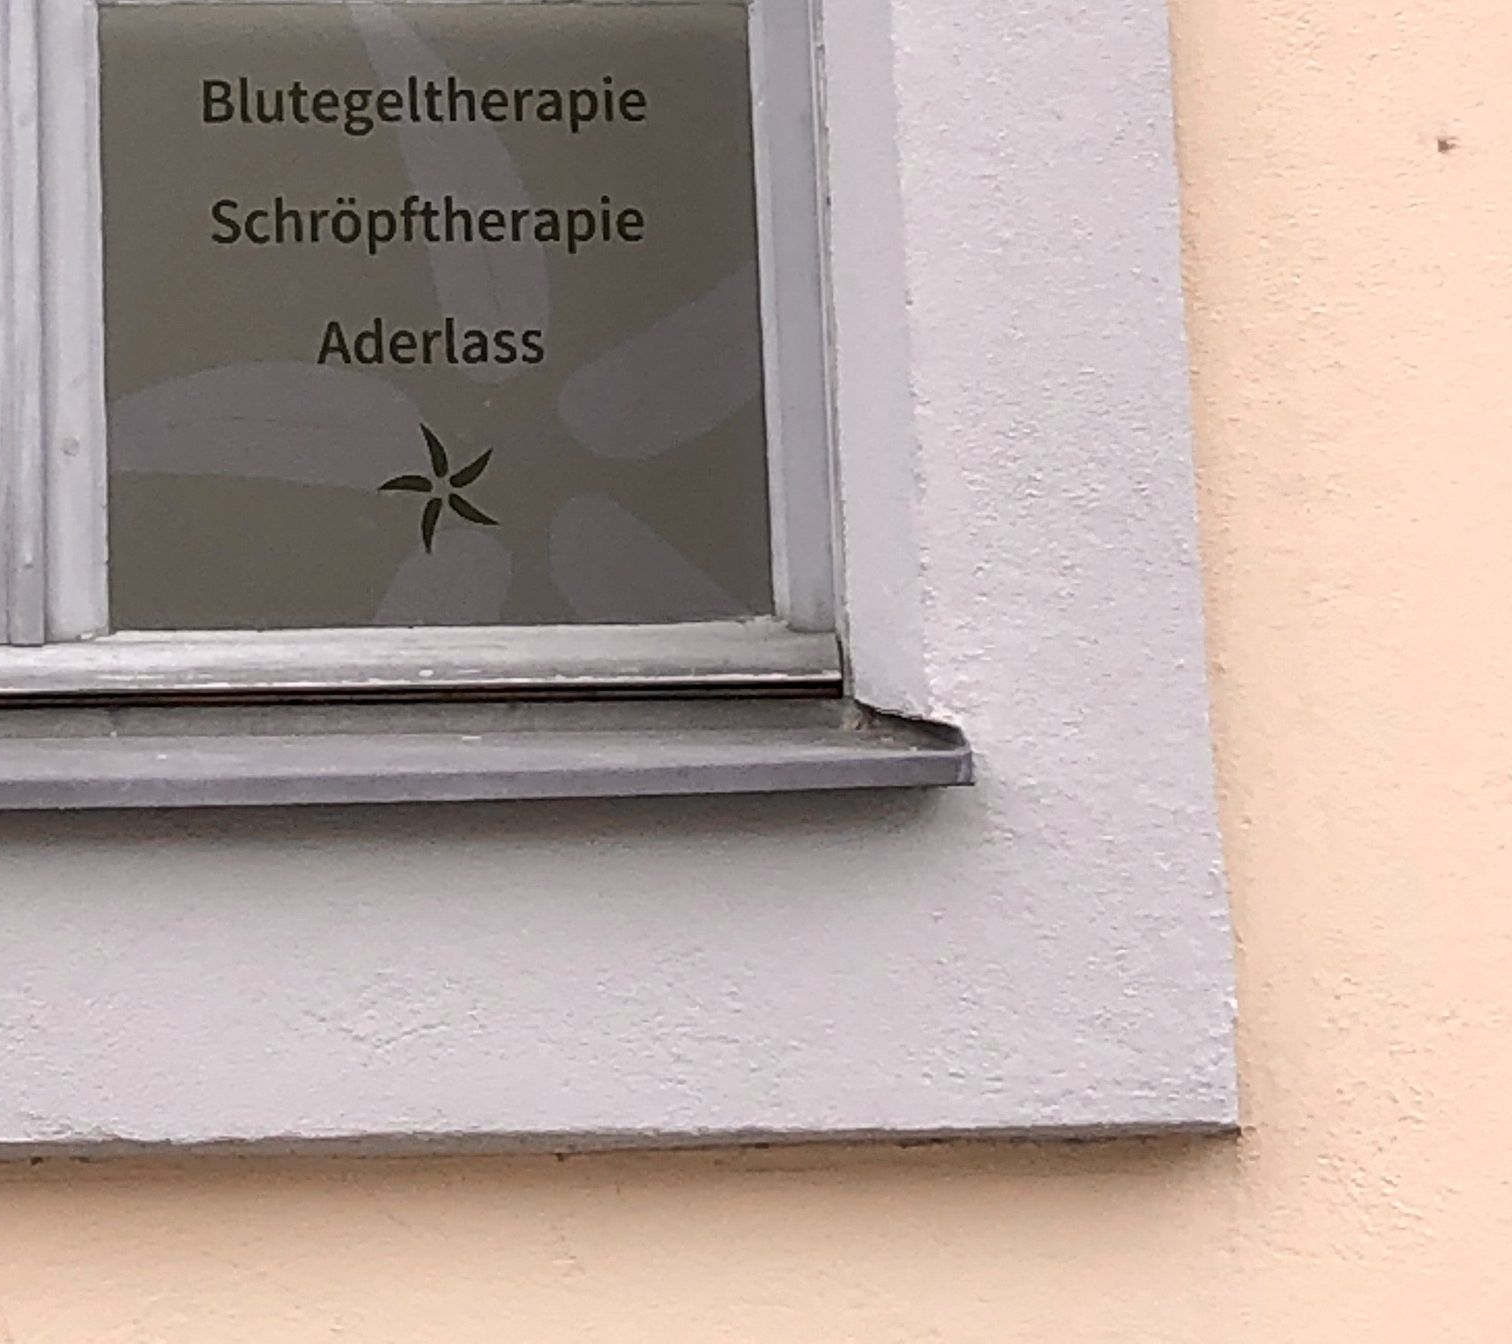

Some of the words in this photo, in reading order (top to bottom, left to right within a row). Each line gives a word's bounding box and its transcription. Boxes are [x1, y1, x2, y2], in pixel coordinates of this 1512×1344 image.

[201, 76, 648, 136] Blutegeltherapie
[210, 195, 645, 254] Schröpftherapie
[317, 317, 544, 365] Aderlass
